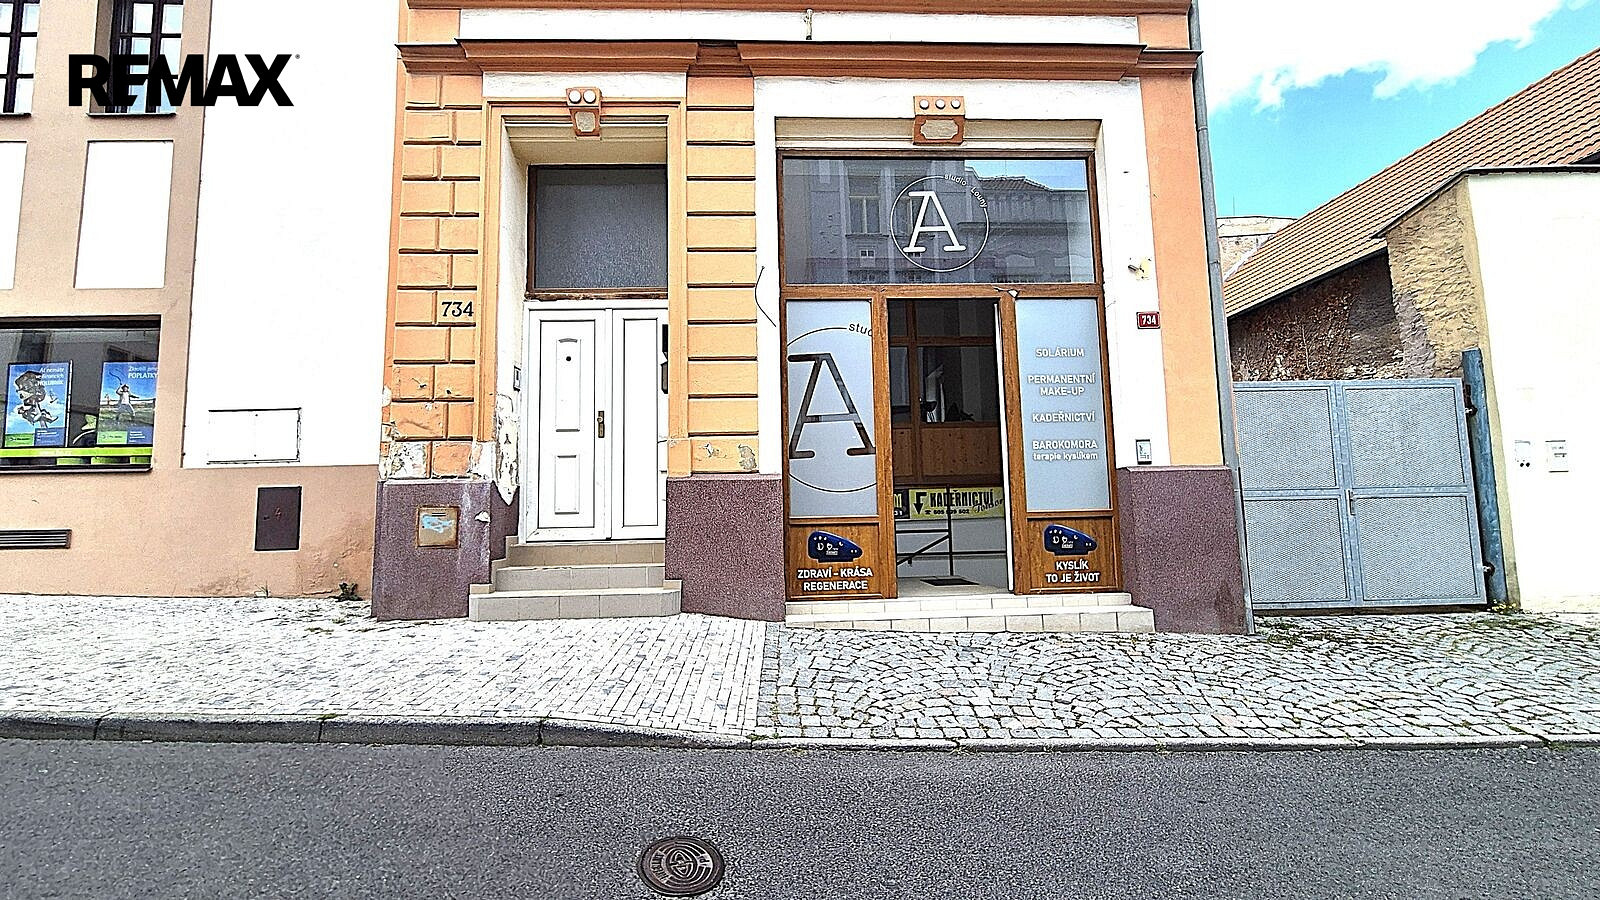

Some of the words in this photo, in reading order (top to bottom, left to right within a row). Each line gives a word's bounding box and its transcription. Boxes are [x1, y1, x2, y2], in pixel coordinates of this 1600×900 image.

[944, 174, 967, 186] studio
[970, 186, 988, 208] Louny
[902, 191, 967, 253] A
[441, 301, 475, 317] 734
[1141, 314, 1157, 325] 734
[1035, 346, 1085, 357] SOLÁRIUM
[1027, 372, 1096, 384] PERMANENTNÍ
[1040, 386, 1085, 396] MAKE-UP
[787, 353, 876, 460] A
[1032, 410, 1096, 422] KADEŘNICTVÍ
[1032, 439, 1099, 450] BAROKOMORA
[1033, 452, 1062, 462] terapie
[1063, 450, 1099, 462] kyslíkem
[929, 488, 994, 507] KADEŘNICTVÍ
[1055, 558, 1089, 571] KYSLÍK
[797, 566, 833, 579] ZDRAVÍ
[840, 565, 873, 578] KRÁSA
[1045, 573, 1058, 583] TO
[1060, 573, 1073, 583] JE
[1073, 570, 1100, 582] ŽIVOT
[803, 580, 869, 591] REGENERACE
